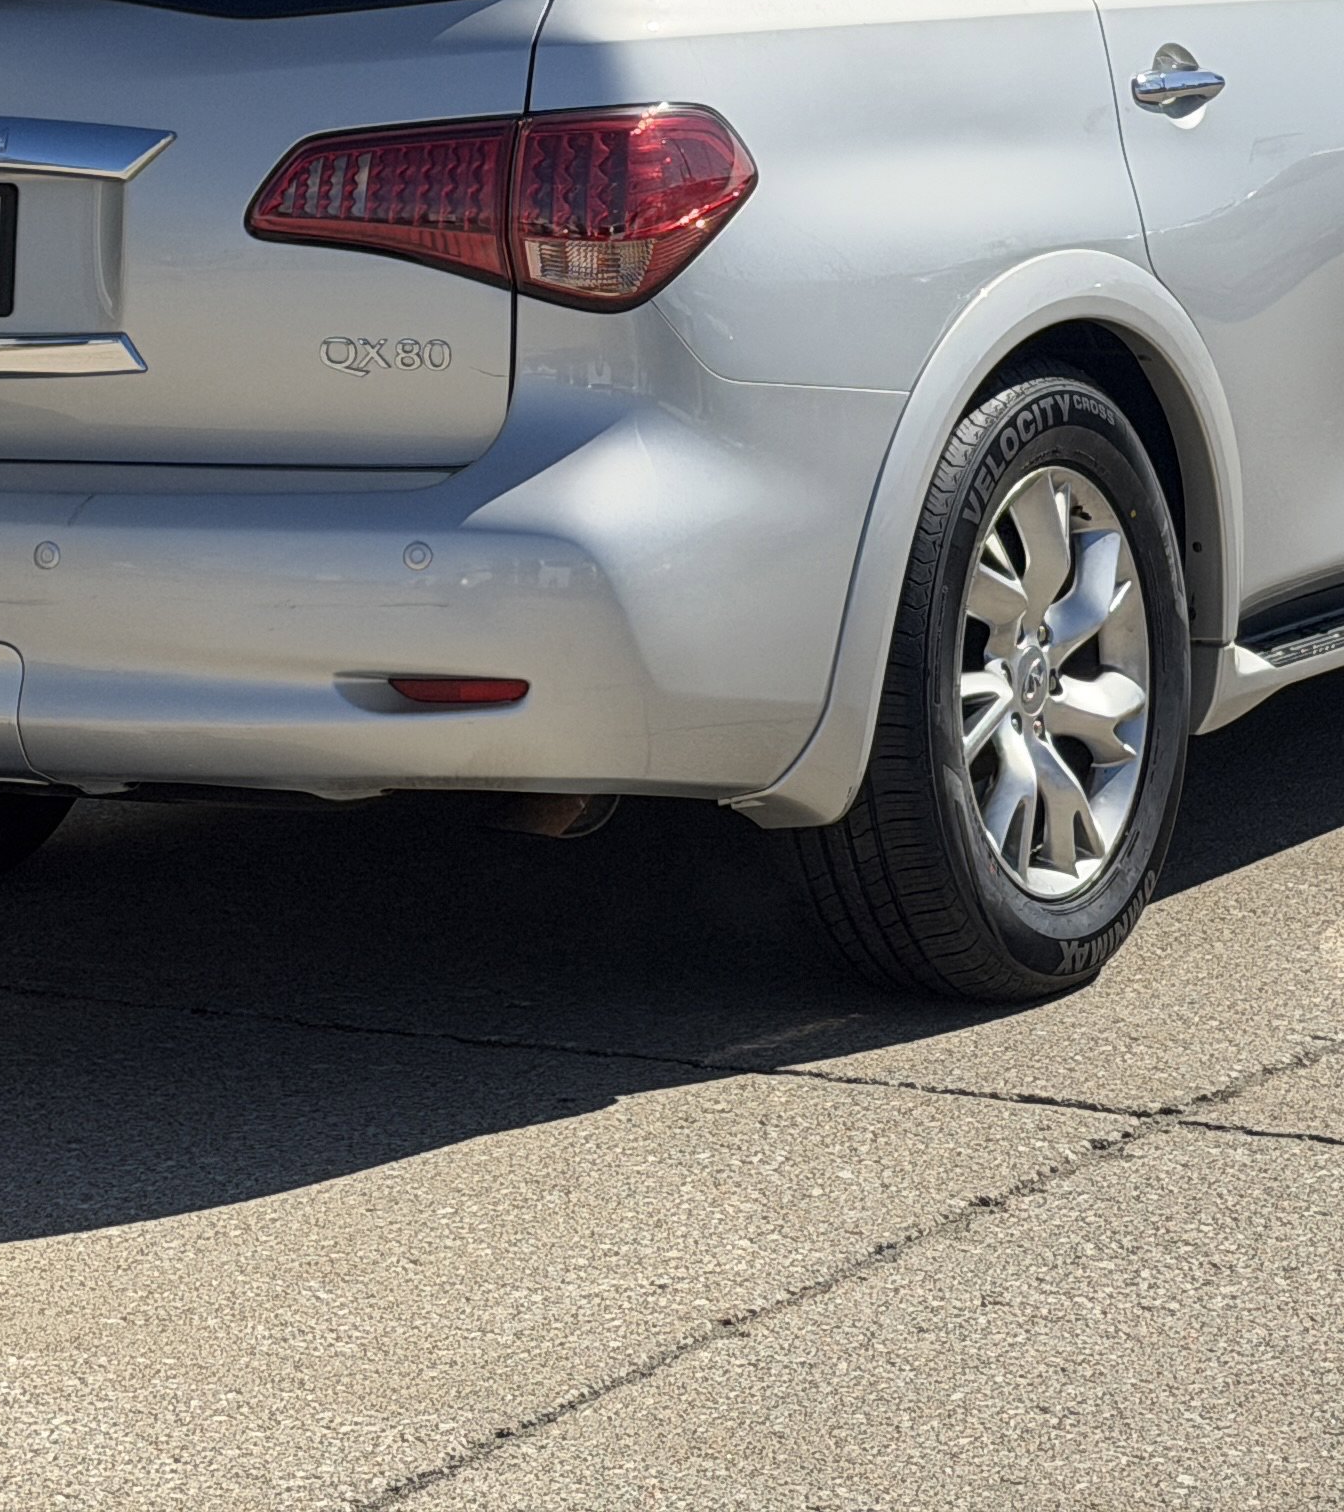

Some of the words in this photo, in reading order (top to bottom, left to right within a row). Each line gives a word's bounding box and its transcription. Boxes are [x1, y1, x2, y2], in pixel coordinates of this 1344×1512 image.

[320, 336, 452, 377] QX80
[962, 393, 1070, 525] VELOCITY
[1073, 394, 1116, 426] CROSS
[1052, 869, 1156, 975] OMNIMAX
